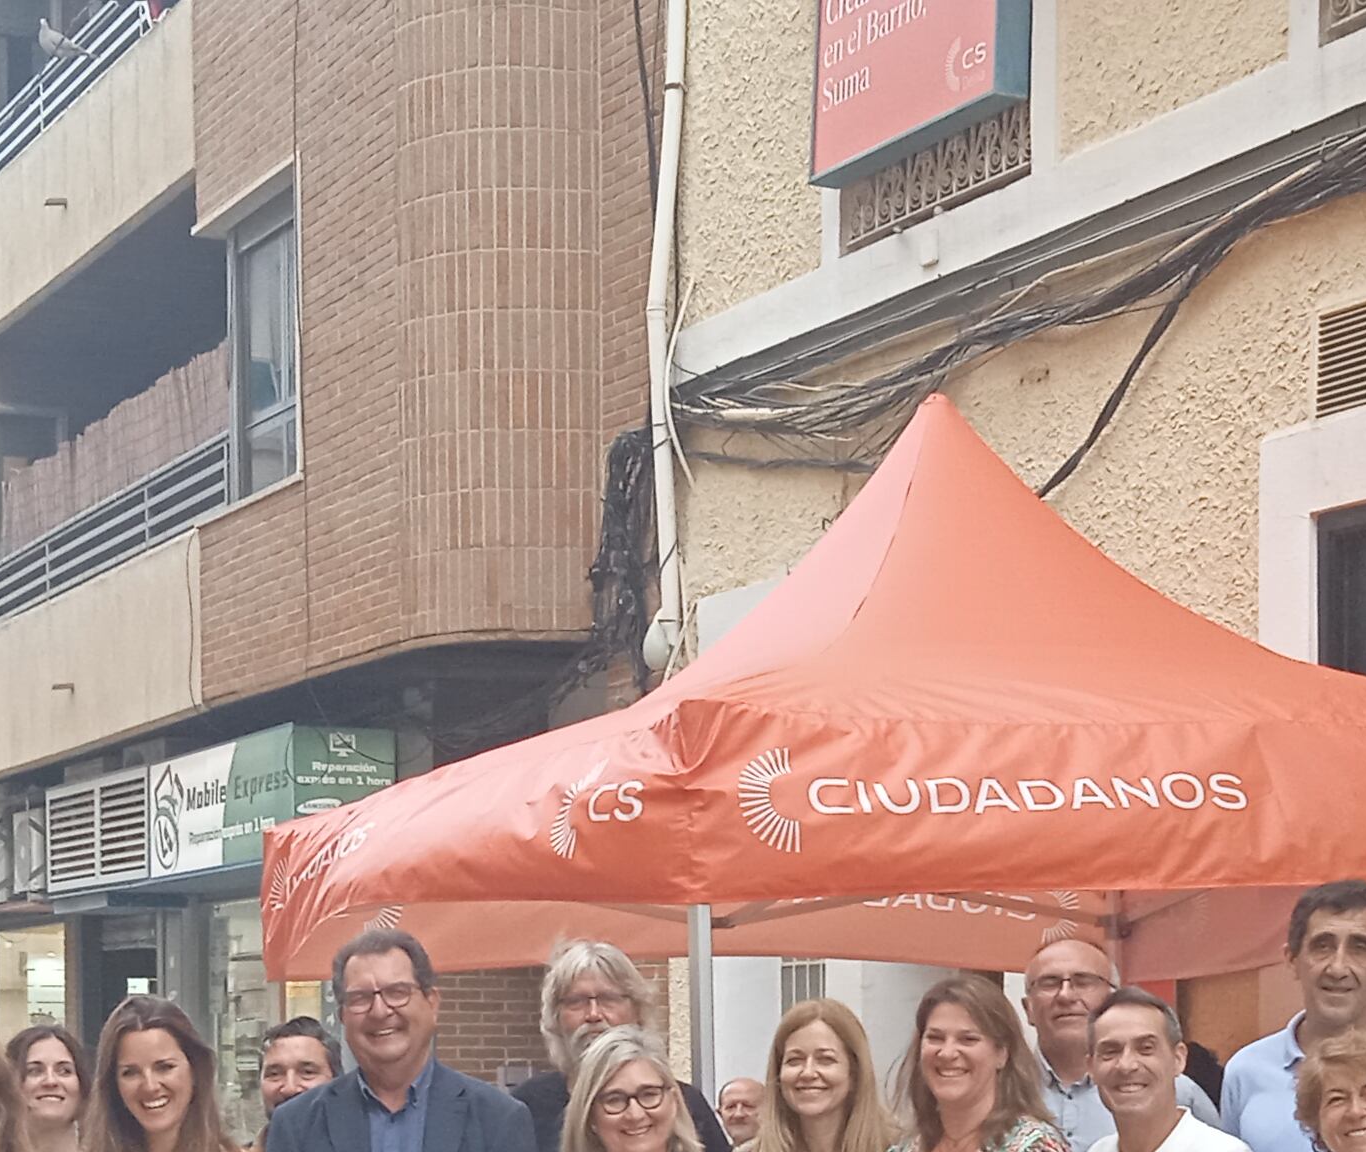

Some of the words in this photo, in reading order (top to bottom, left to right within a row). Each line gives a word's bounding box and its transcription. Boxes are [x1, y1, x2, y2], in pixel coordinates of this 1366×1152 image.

[823, 39, 844, 69] en
[847, 17, 862, 56] el
[962, 42, 987, 69] CS
[822, 65, 870, 112] Suma
[186, 779, 227, 811] Mobile
[234, 769, 289, 804] Express
[588, 780, 644, 822] CS
[808, 772, 1248, 815] CIUDADANOS
